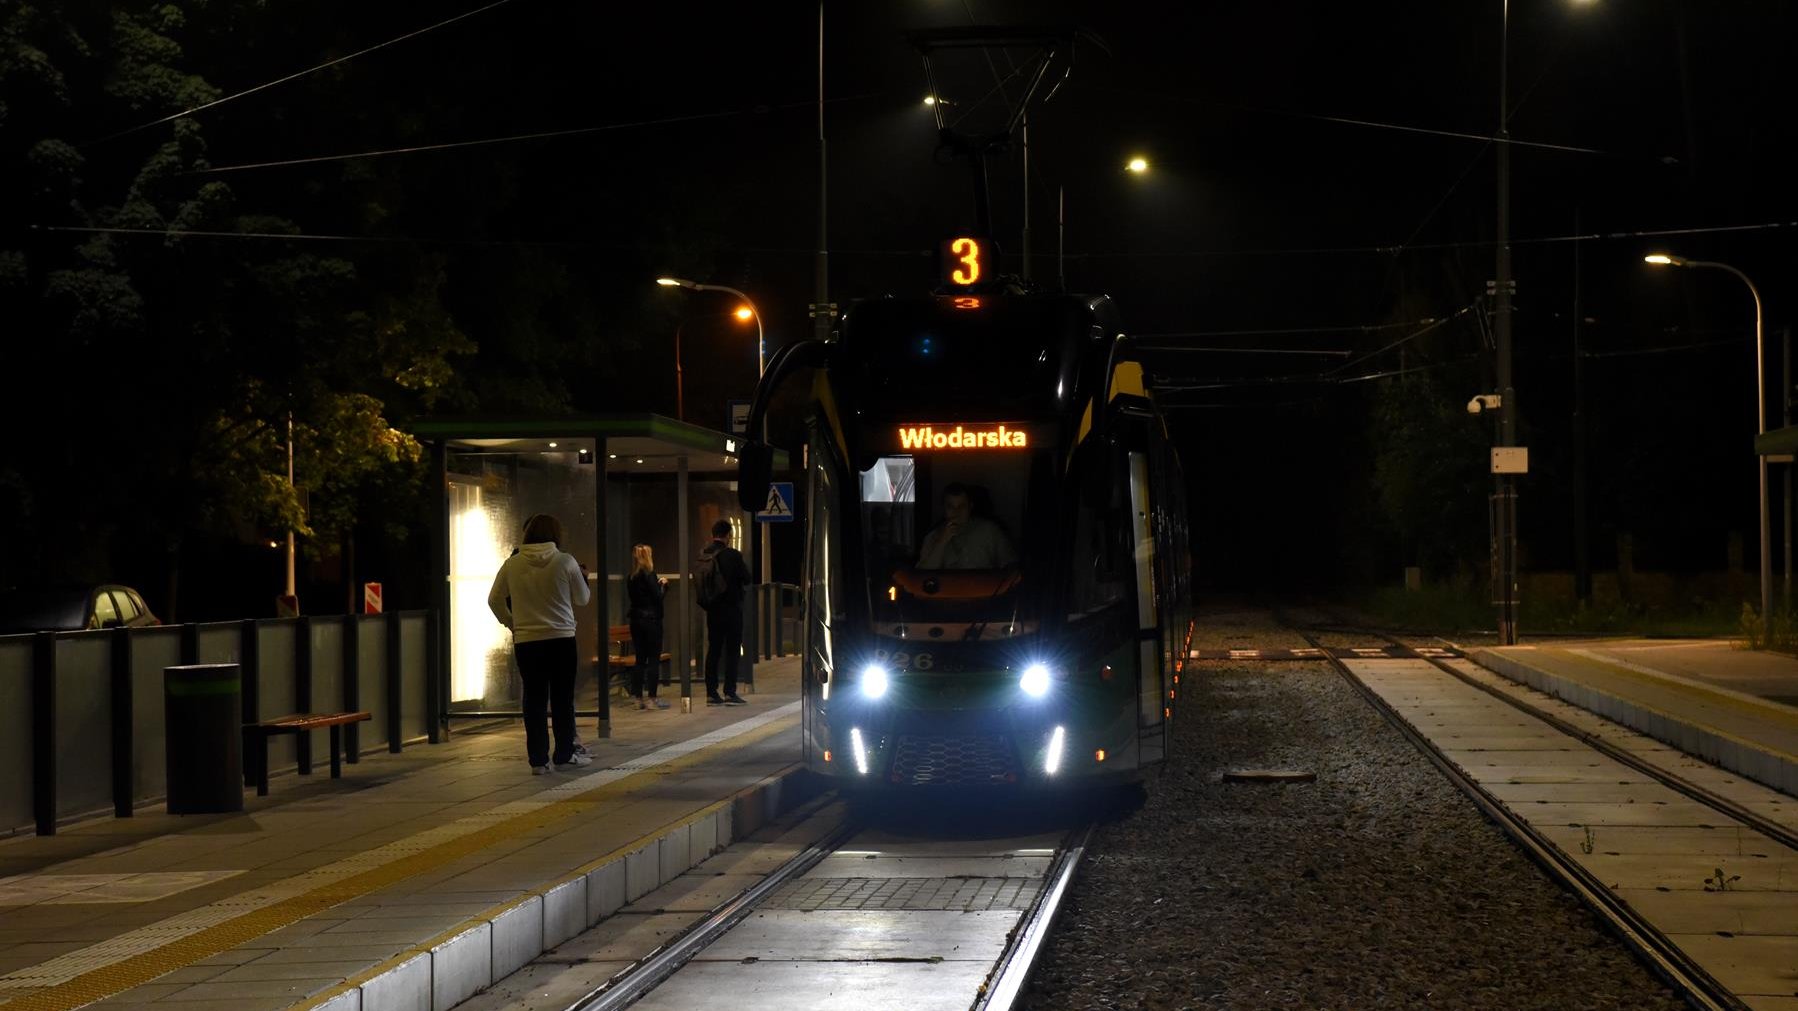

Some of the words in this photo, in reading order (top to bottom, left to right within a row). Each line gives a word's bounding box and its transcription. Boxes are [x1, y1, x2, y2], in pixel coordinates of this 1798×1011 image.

[951, 238, 980, 285] 3
[899, 425, 1027, 449] Włodarska
[888, 586, 897, 601] 1
